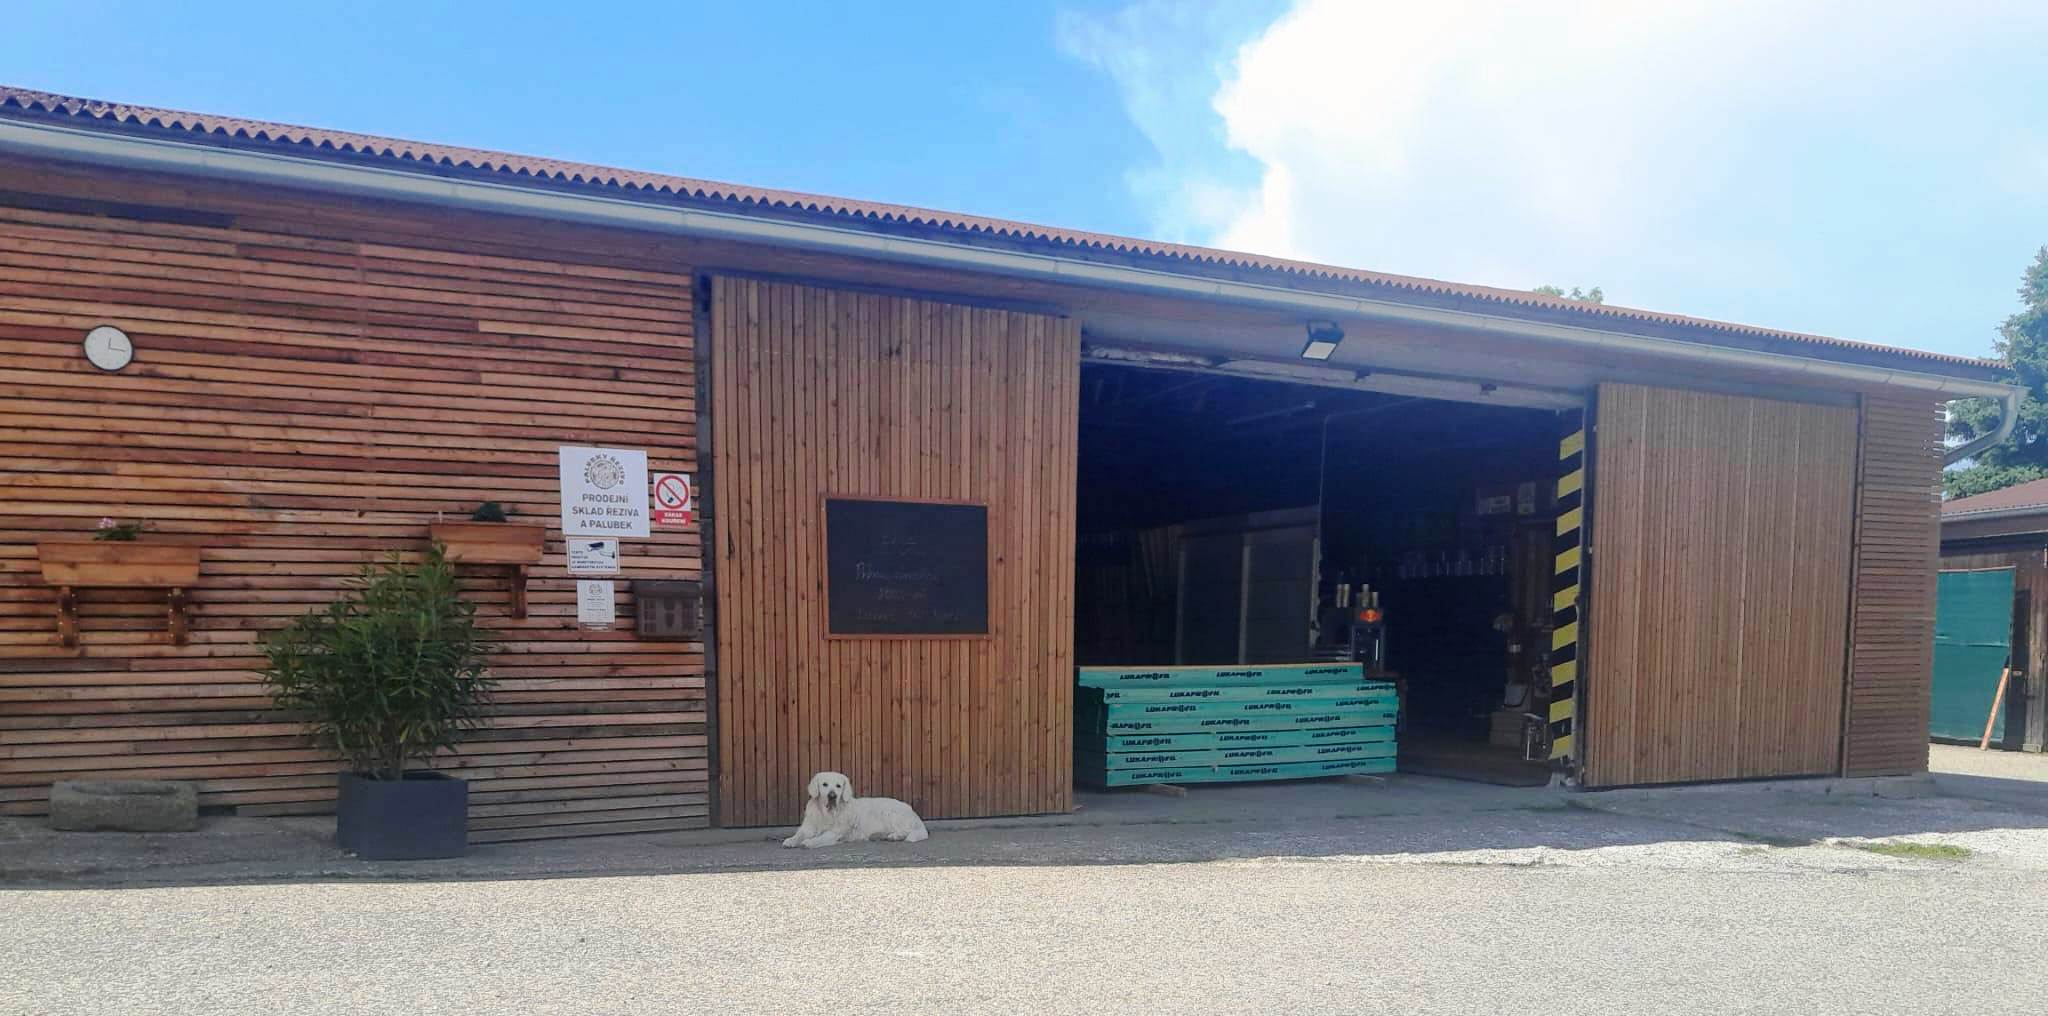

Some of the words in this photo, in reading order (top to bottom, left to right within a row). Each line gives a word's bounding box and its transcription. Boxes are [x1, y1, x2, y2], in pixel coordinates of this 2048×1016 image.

[572, 506, 604, 516] SKLAD
[580, 520, 587, 528] A
[589, 520, 633, 530] PALUBEK
